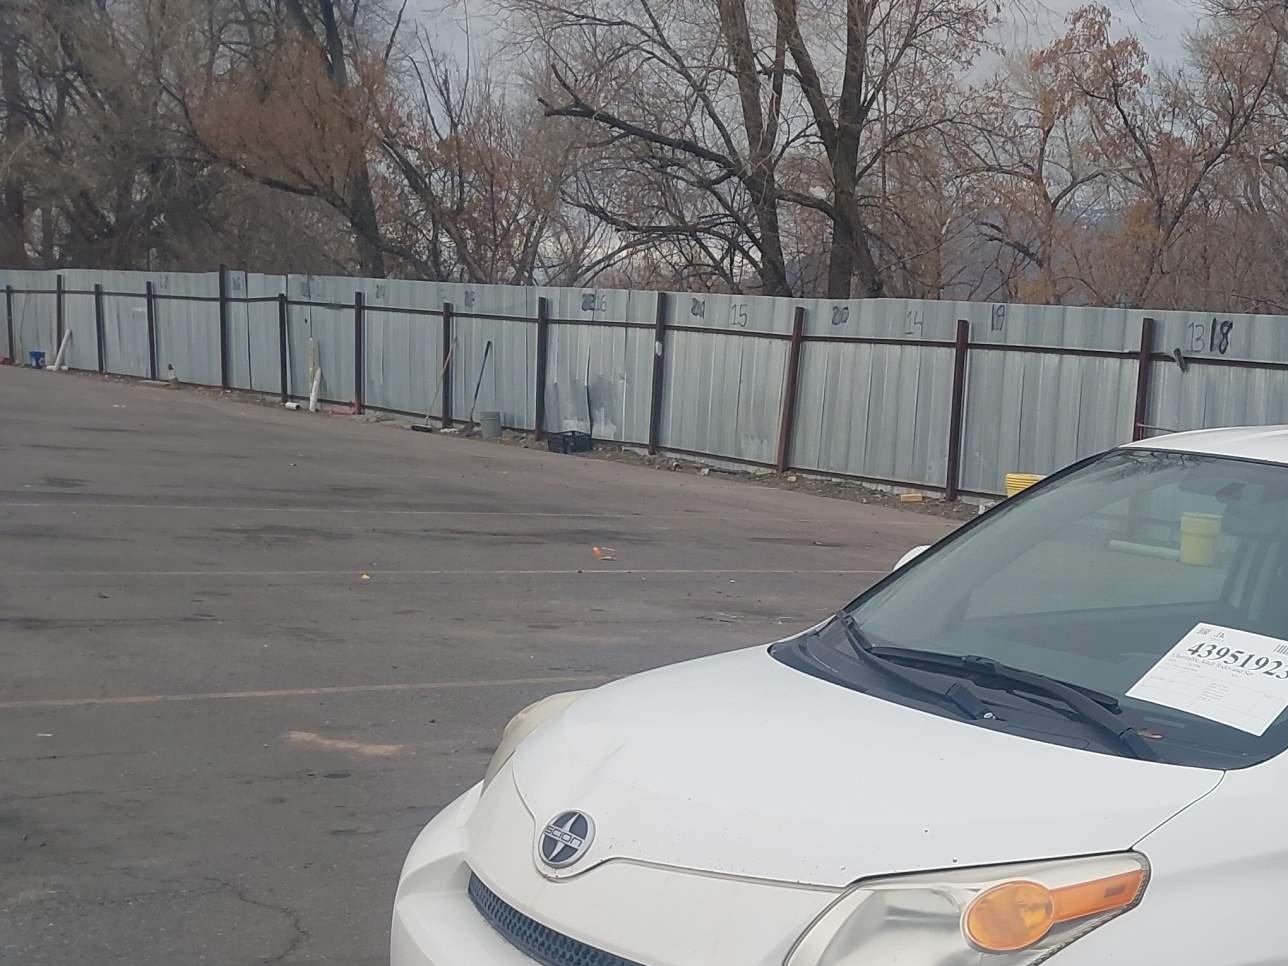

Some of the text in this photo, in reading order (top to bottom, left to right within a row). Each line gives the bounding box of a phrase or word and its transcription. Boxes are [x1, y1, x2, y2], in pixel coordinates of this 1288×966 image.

[731, 303, 749, 328] 15
[904, 310, 924, 337] 14
[1185, 321, 1206, 353] 13
[1209, 317, 1234, 355] 18
